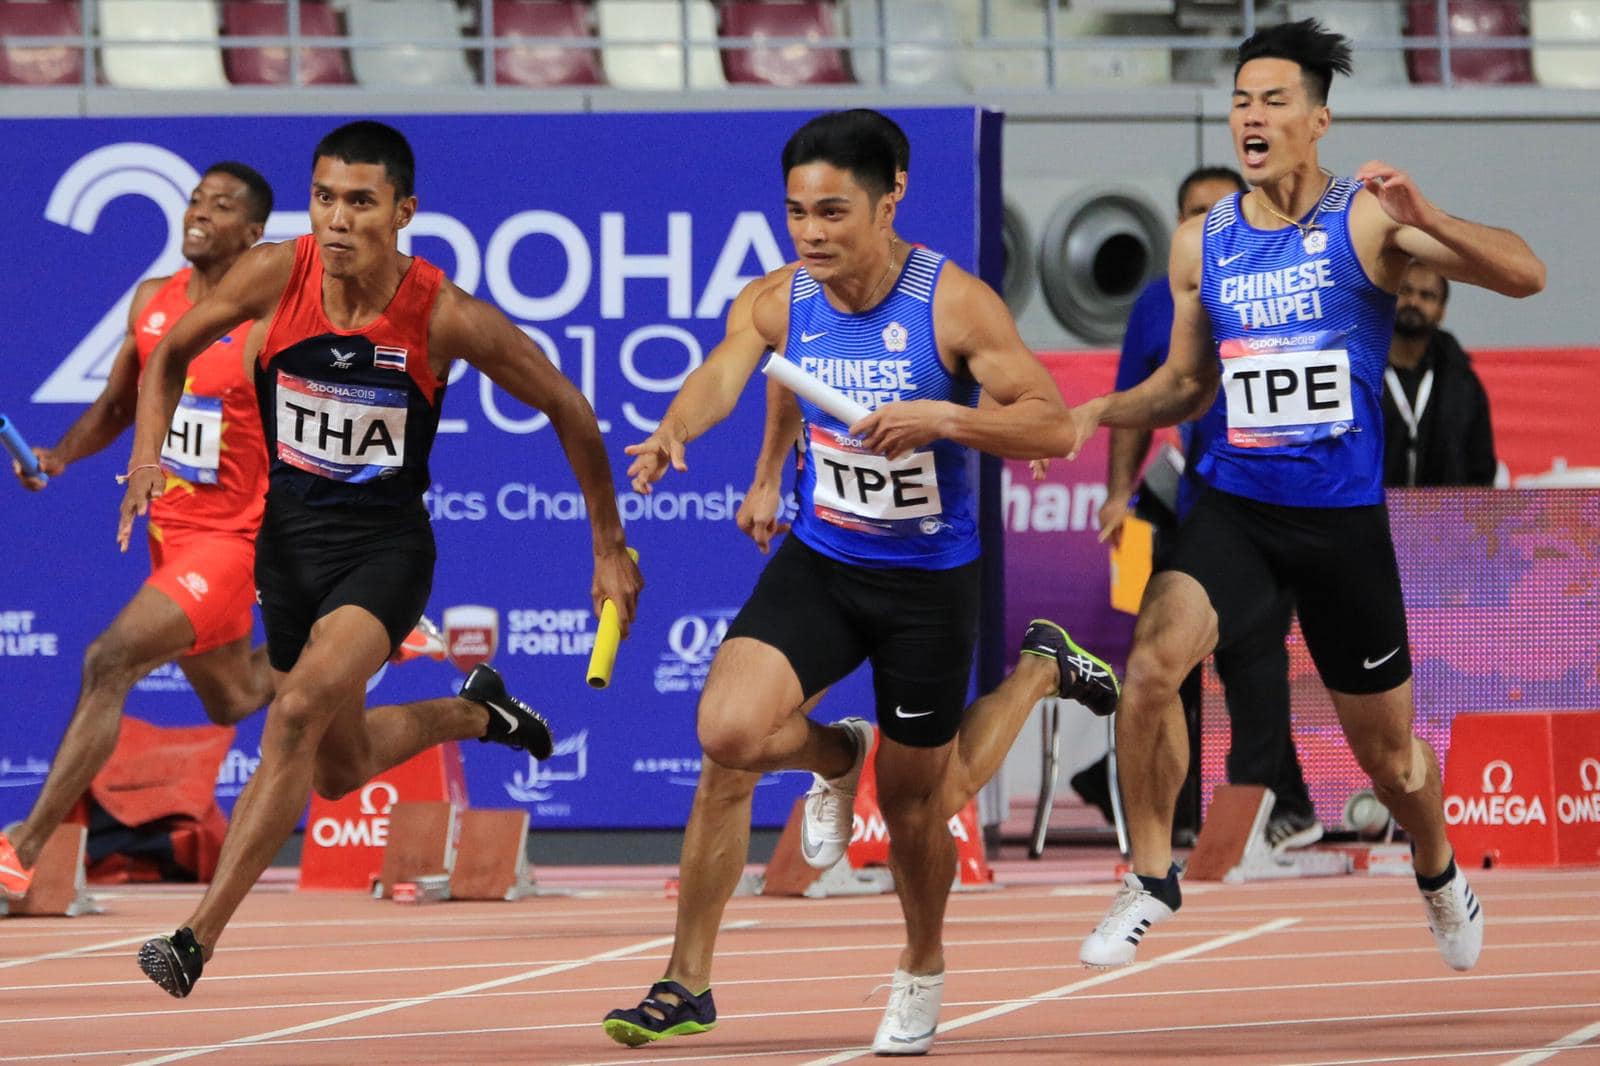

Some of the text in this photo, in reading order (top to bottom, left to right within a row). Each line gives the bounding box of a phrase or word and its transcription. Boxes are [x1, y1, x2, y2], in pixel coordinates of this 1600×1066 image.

[398, 210, 789, 321] DOHA
[1220, 259, 1335, 303] CHINESE
[1234, 290, 1323, 329] TAIPEI
[800, 356, 918, 391] CHINESE
[1232, 364, 1340, 415] TPE
[168, 421, 202, 457] HI
[285, 401, 397, 457] THA
[823, 458, 928, 508] TPE
[0, 610, 35, 633] RT
[507, 609, 591, 633] SPORT
[507, 632, 560, 655] FOR
[561, 632, 596, 655] LIF
[668, 615, 728, 664] QA
[1444, 795, 1547, 825] OMEGA
[1557, 794, 1600, 824] OME
[312, 818, 390, 848] OME
